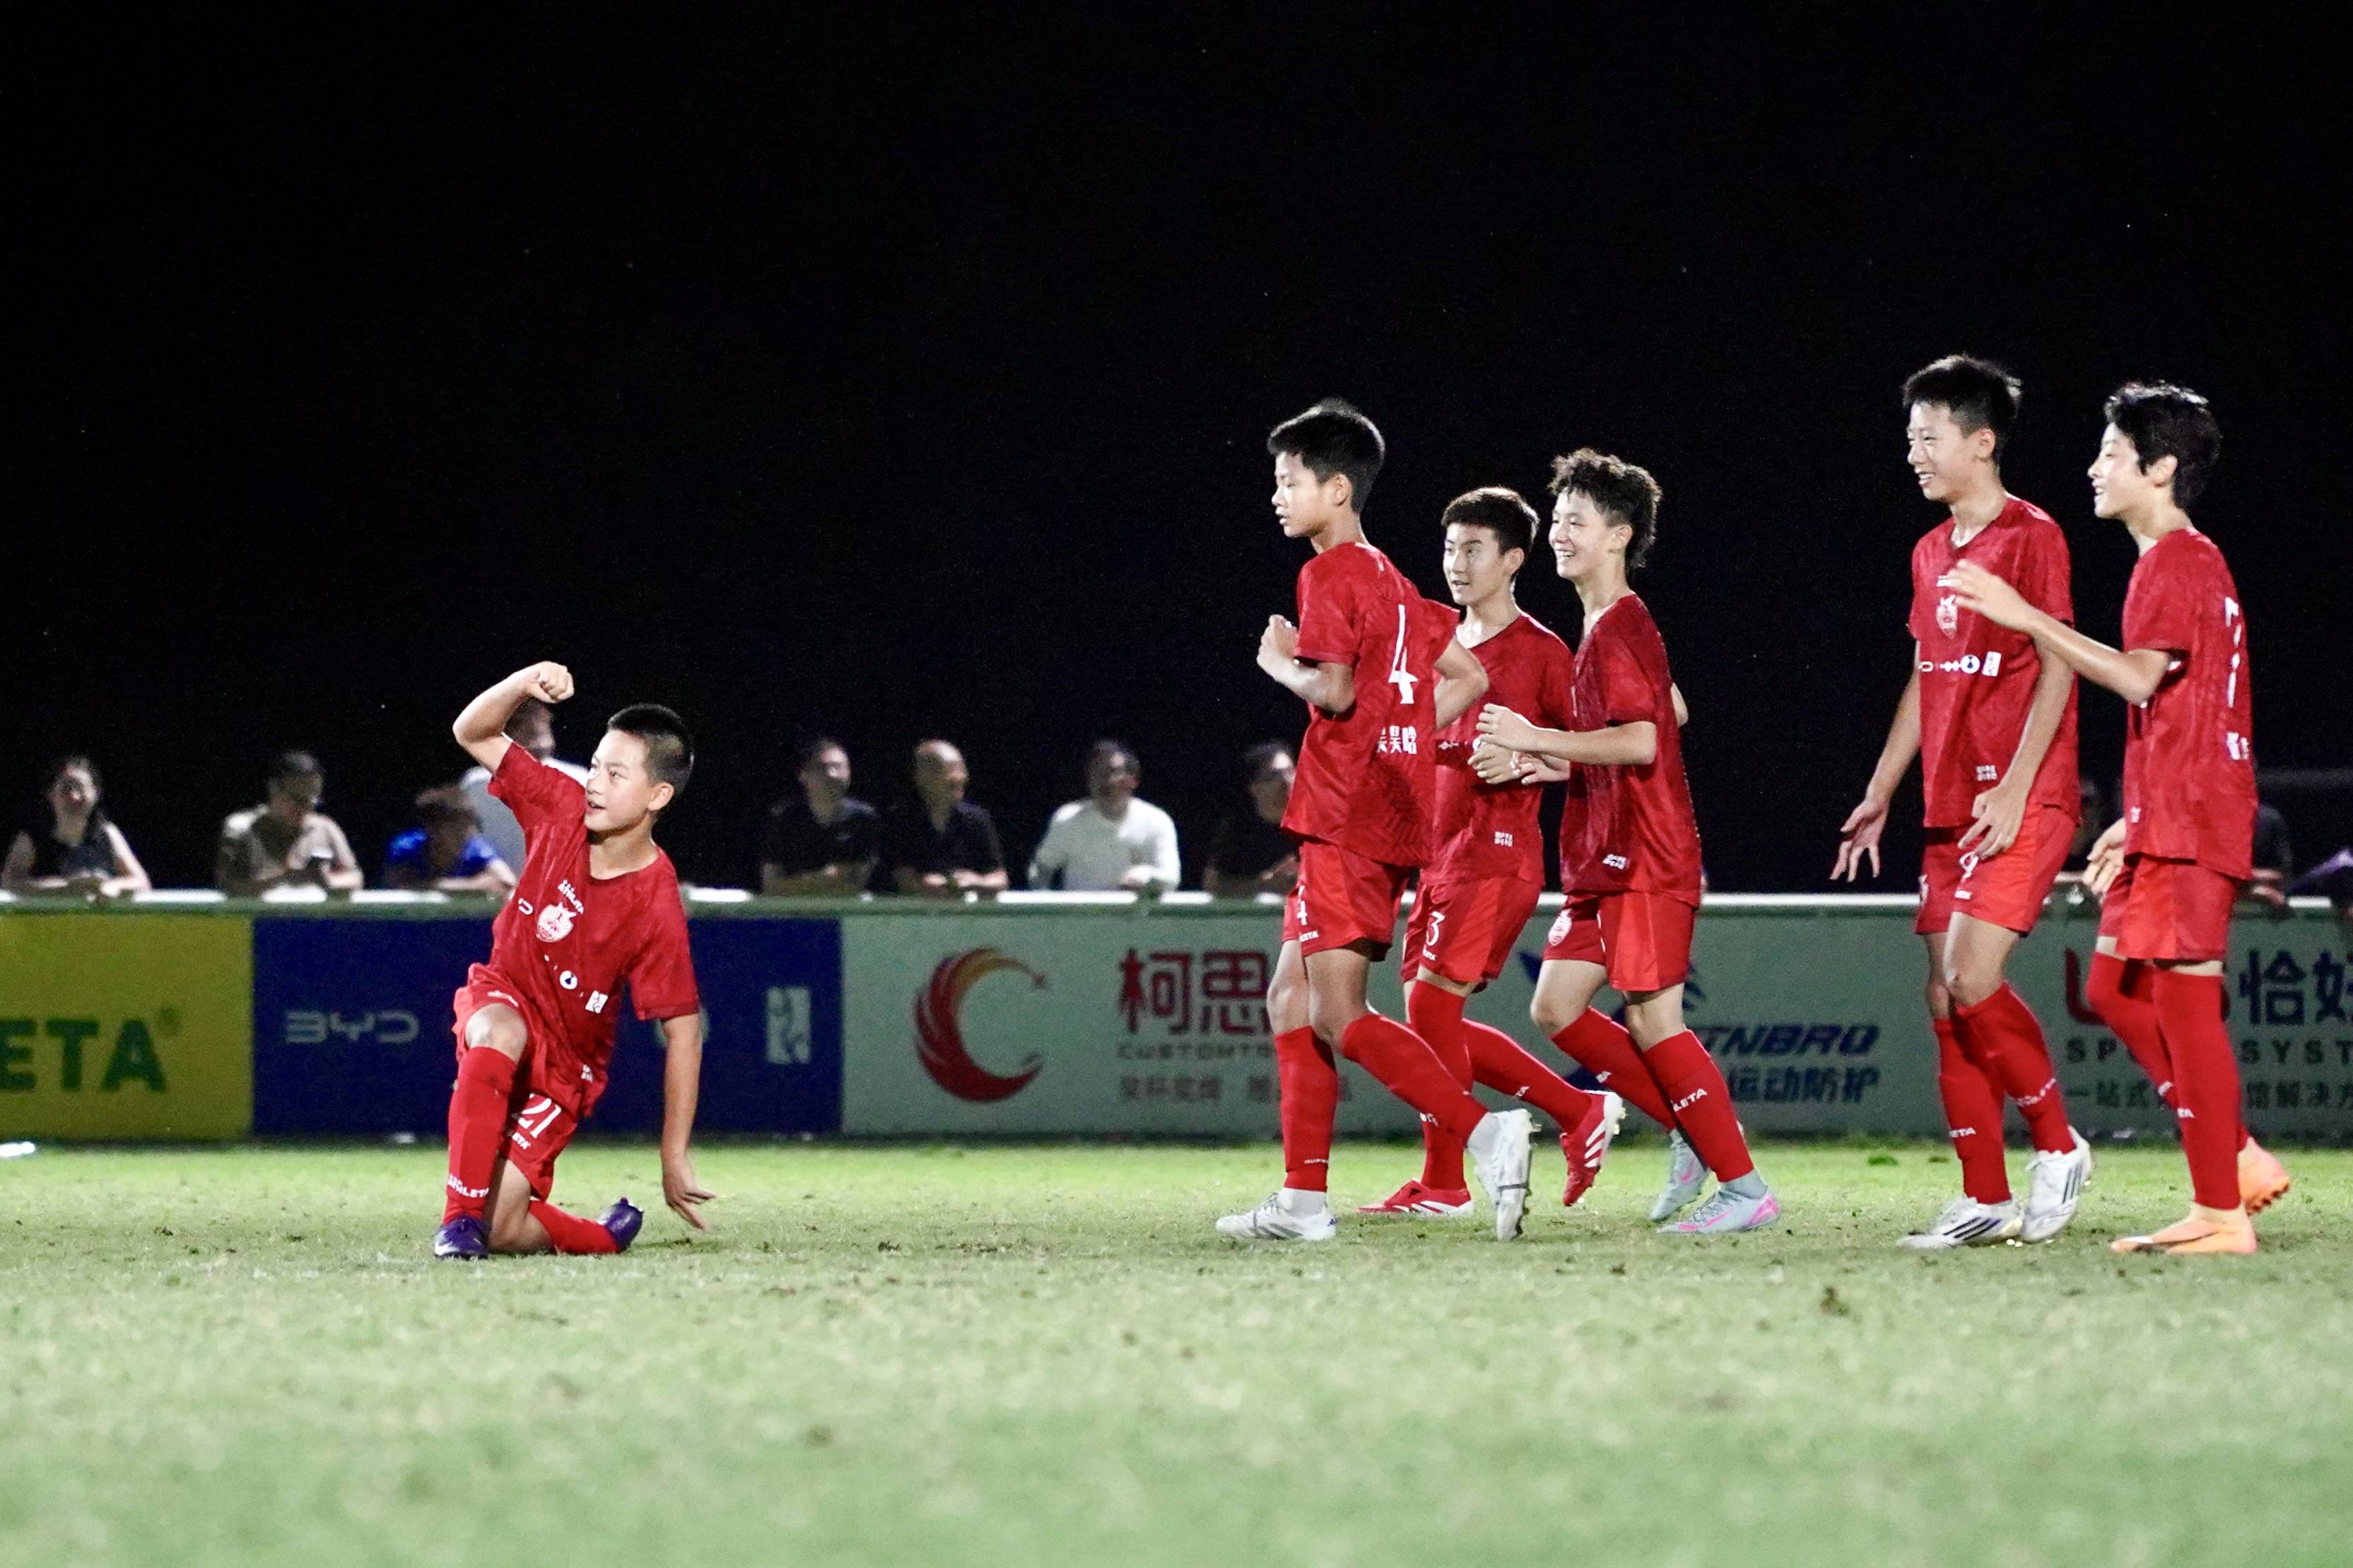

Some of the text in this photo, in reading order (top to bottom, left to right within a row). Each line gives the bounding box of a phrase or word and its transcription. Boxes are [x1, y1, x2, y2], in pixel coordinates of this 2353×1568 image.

[1388, 604, 1418, 704] 4
[1426, 911, 1445, 946] 3
[0, 1016, 167, 1092] ETA
[284, 1008, 421, 1044] BYD
